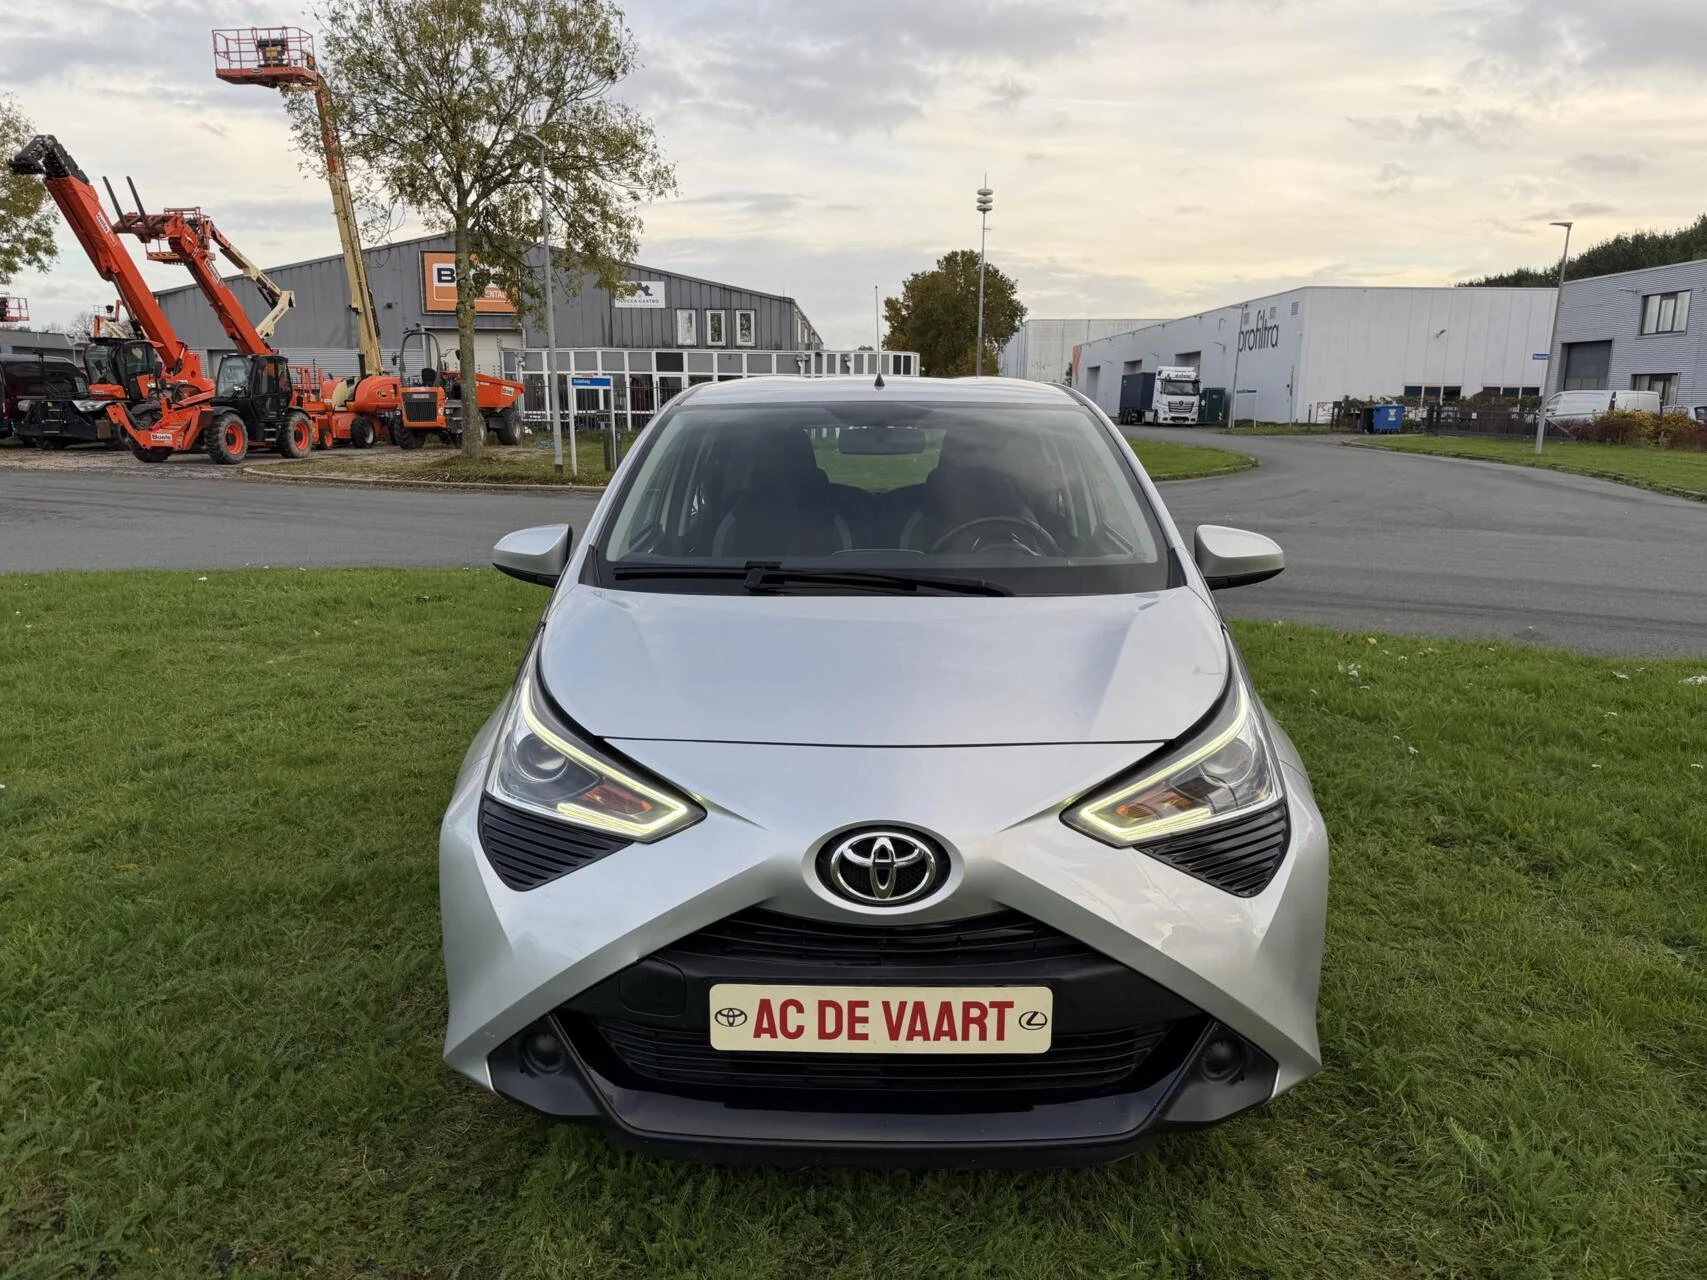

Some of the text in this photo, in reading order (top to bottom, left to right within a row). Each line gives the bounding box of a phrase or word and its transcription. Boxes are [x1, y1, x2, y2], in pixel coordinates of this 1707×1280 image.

[1238, 309, 1279, 352] profiltra
[752, 998, 1015, 1042] AC DE VAART
